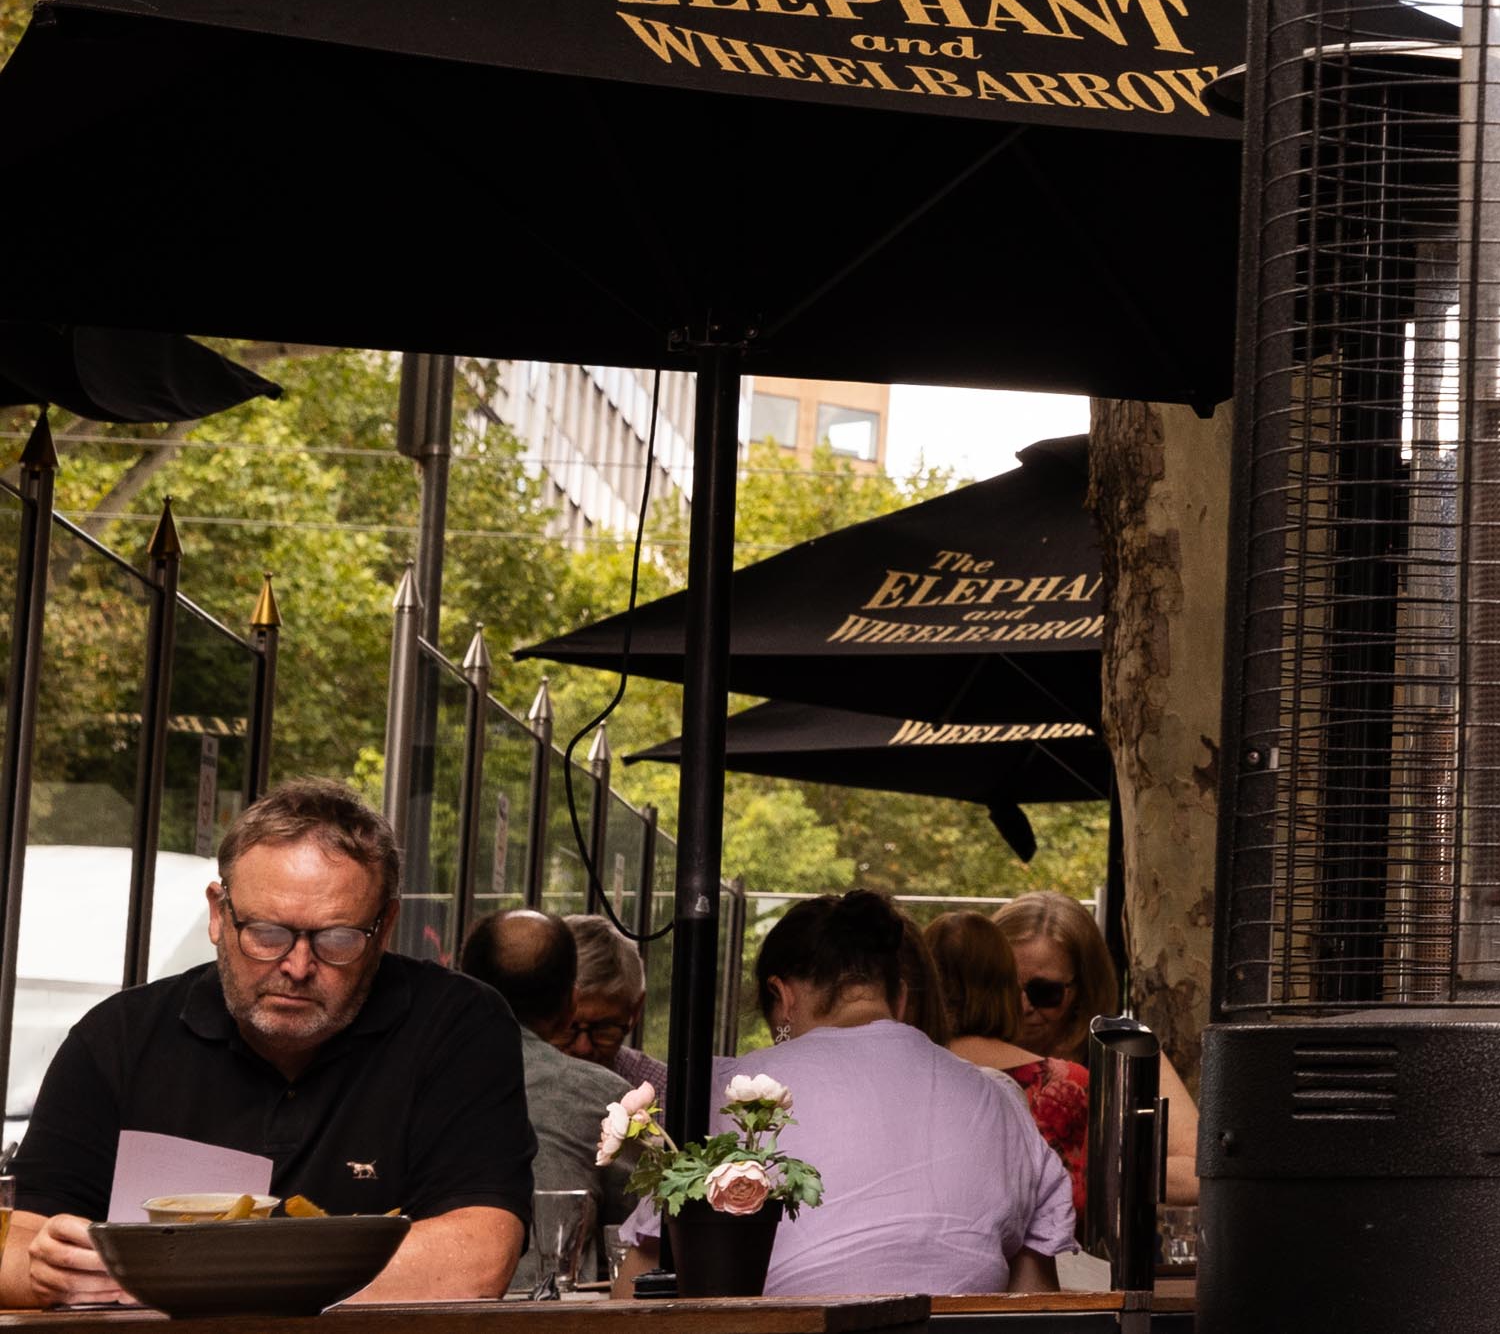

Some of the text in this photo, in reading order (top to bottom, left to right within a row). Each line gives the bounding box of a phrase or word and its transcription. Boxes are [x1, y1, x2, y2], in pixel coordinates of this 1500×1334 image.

[850, 33, 983, 60] and
[928, 550, 995, 574] The
[861, 568, 1104, 610] ELEPHA
[962, 605, 1036, 622] and
